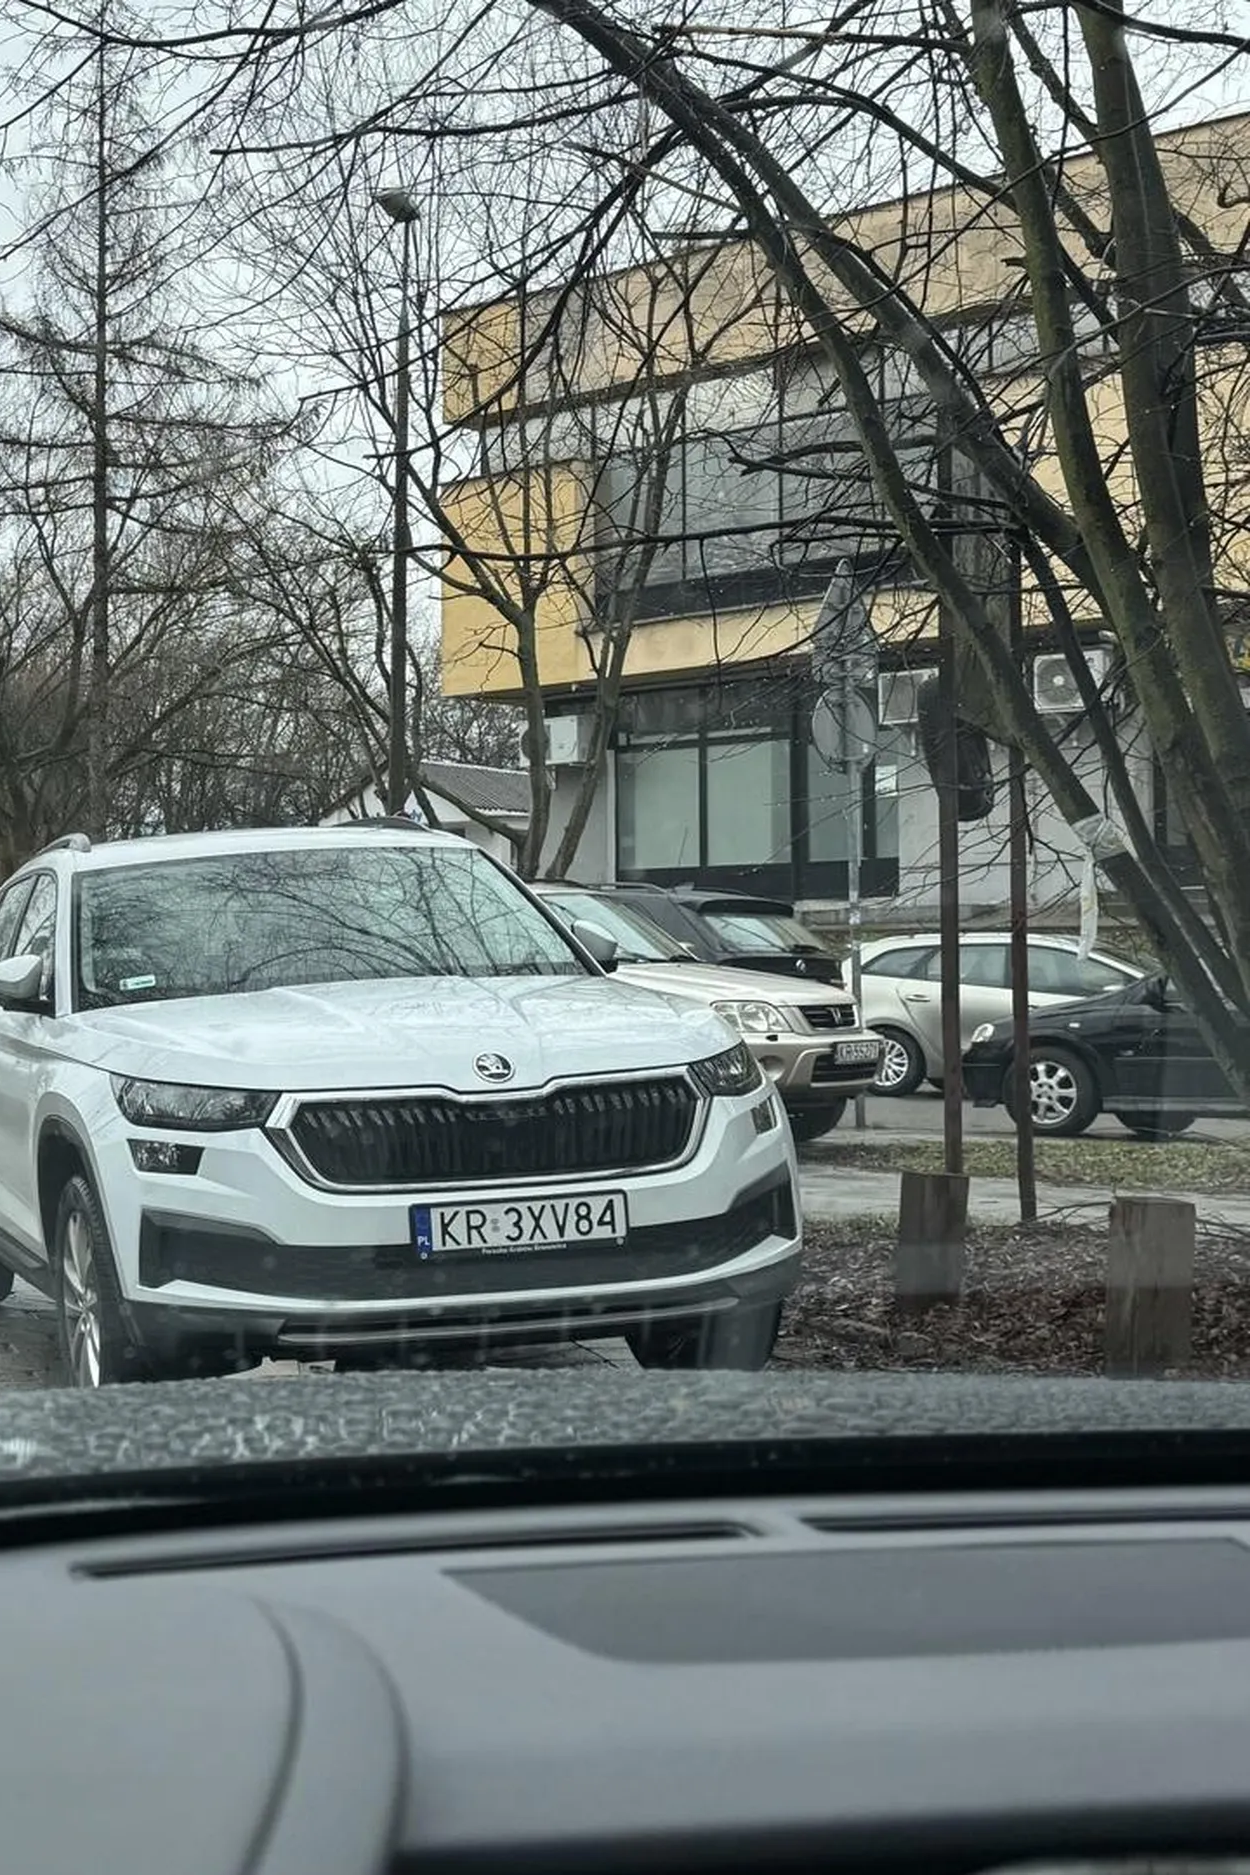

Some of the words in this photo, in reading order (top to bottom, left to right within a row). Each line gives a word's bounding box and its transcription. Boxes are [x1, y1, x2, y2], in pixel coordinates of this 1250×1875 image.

[440, 1209, 488, 1247] KR
[504, 1199, 617, 1242] 3XV84
[417, 1236, 430, 1246] PL
